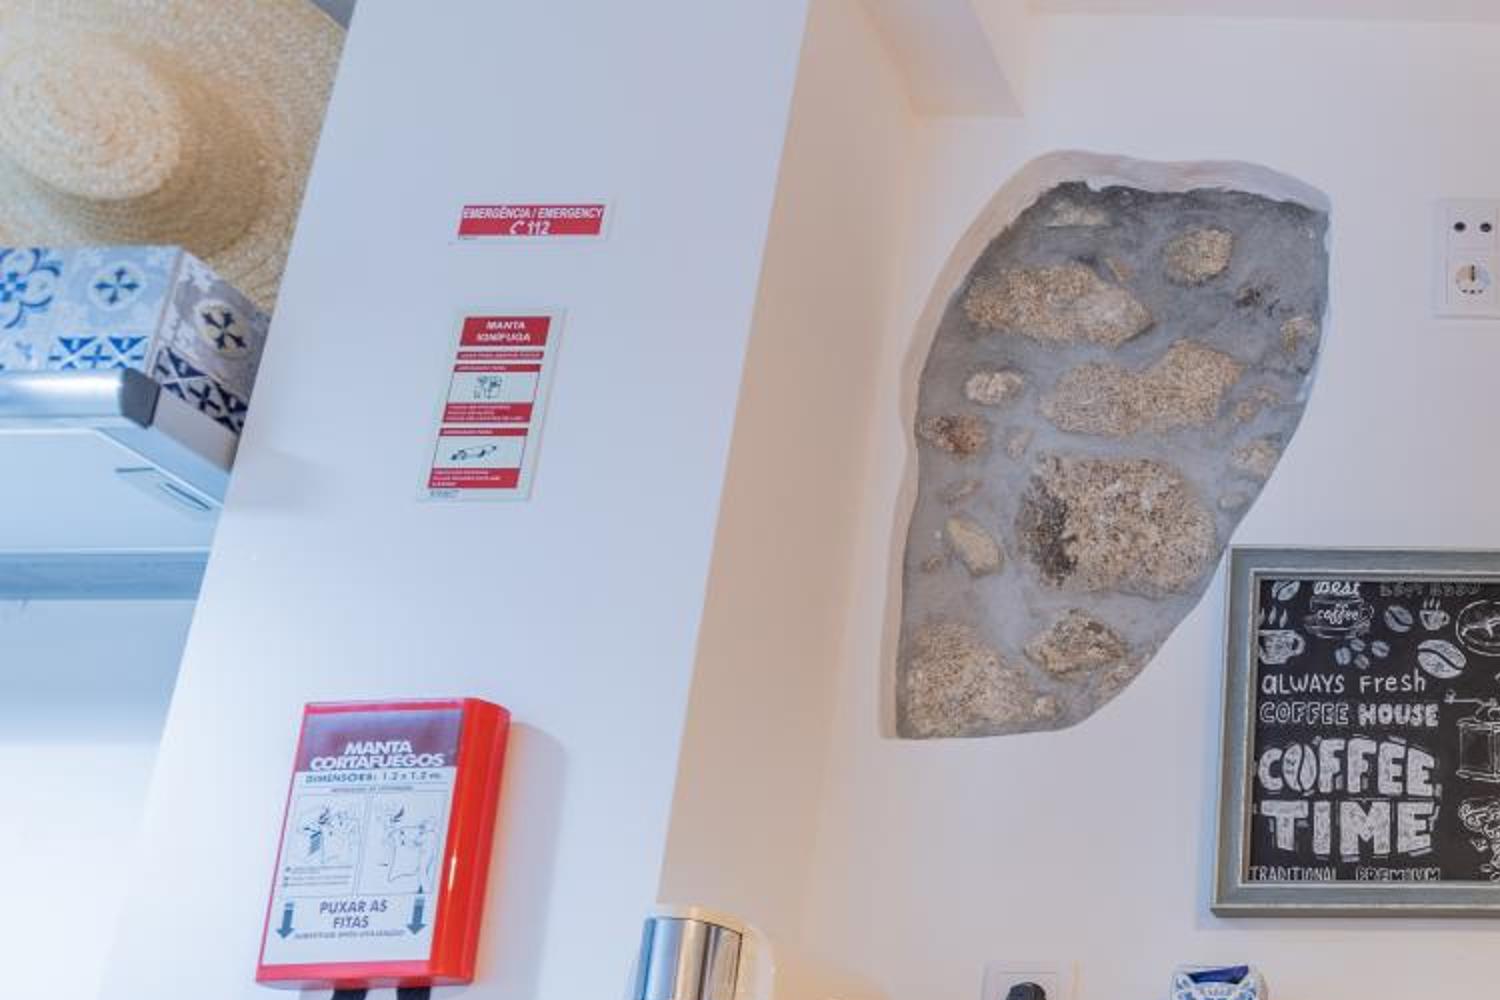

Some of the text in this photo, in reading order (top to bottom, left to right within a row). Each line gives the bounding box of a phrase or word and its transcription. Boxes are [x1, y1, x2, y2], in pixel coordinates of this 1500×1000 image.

[537, 207, 603, 219] EMERGENCY
[526, 221, 550, 235] 112
[1359, 668, 1427, 694] Fresh
[1259, 701, 1440, 727] COFFEE HOUSE
[344, 741, 413, 755] MANTA
[310, 753, 446, 771] CORTAFUEGOS
[1257, 736, 1436, 798] COFFEE
[1260, 800, 1436, 856] TIME
[320, 900, 388, 914] PUXAR AS
[333, 916, 369, 929] FITAS
